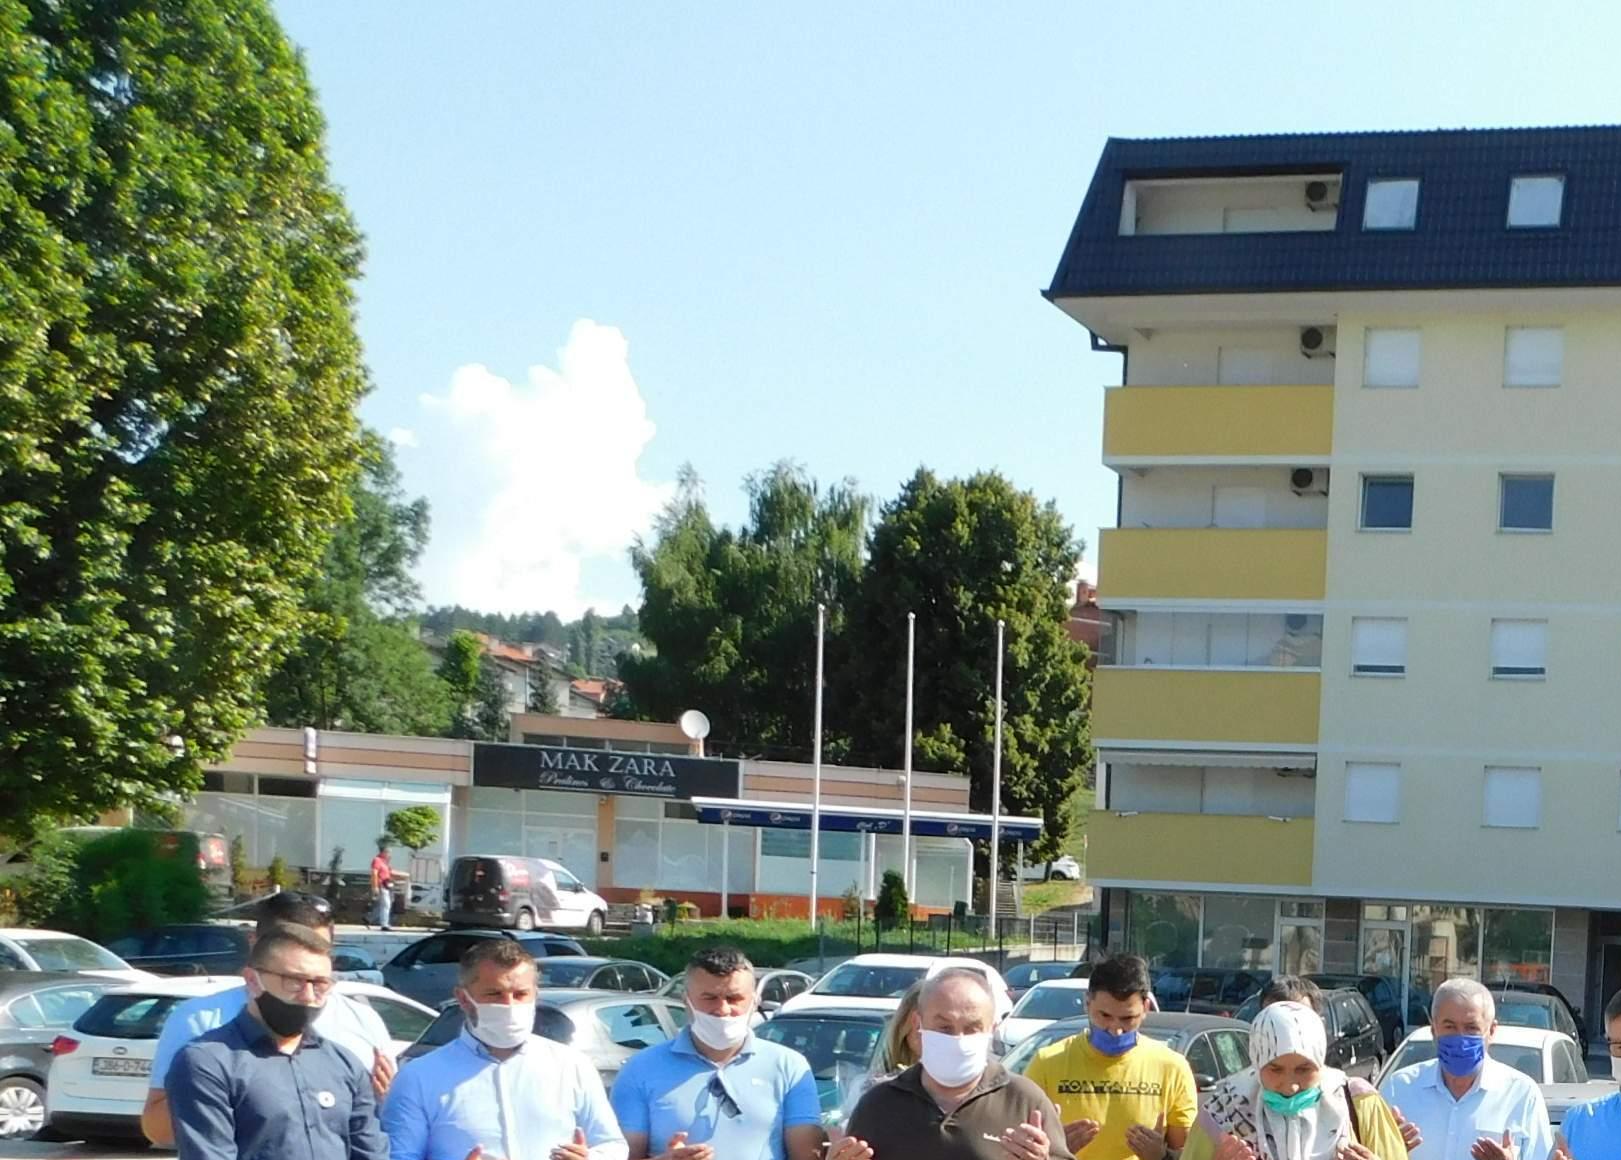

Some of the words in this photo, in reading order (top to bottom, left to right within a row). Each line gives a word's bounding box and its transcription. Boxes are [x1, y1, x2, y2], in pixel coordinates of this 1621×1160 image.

[540, 751, 599, 772] MAK
[608, 755, 676, 777] ZARA
[1099, 1081, 1161, 1096] TAILOR
